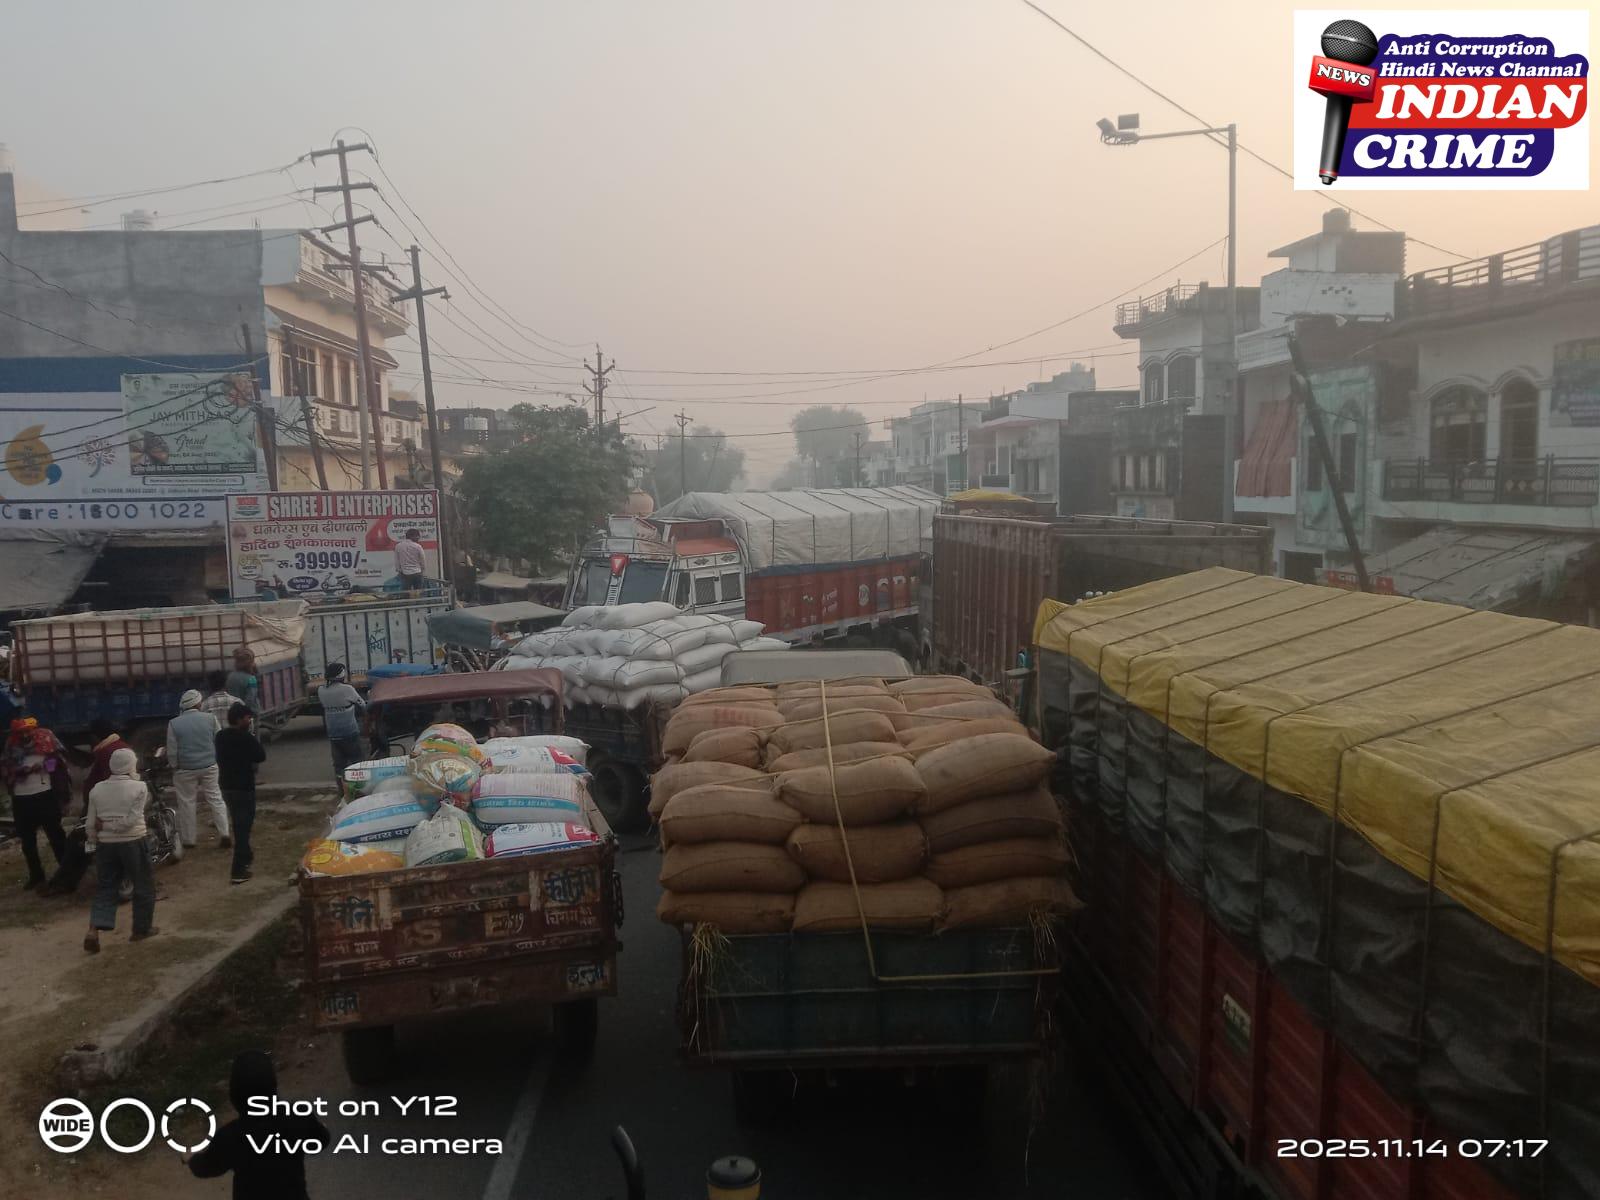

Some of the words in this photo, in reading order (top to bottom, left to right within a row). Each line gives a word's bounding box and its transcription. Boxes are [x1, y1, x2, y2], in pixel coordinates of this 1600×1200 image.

[149, 502, 206, 519] 1022
[271, 494, 318, 518] SHREE
[321, 494, 333, 517] JI
[339, 493, 434, 517] ENTERPRISES
[253, 521, 298, 535] धनतेरस
[322, 520, 368, 534] दीपावली
[240, 539, 280, 551] हार्दिक
